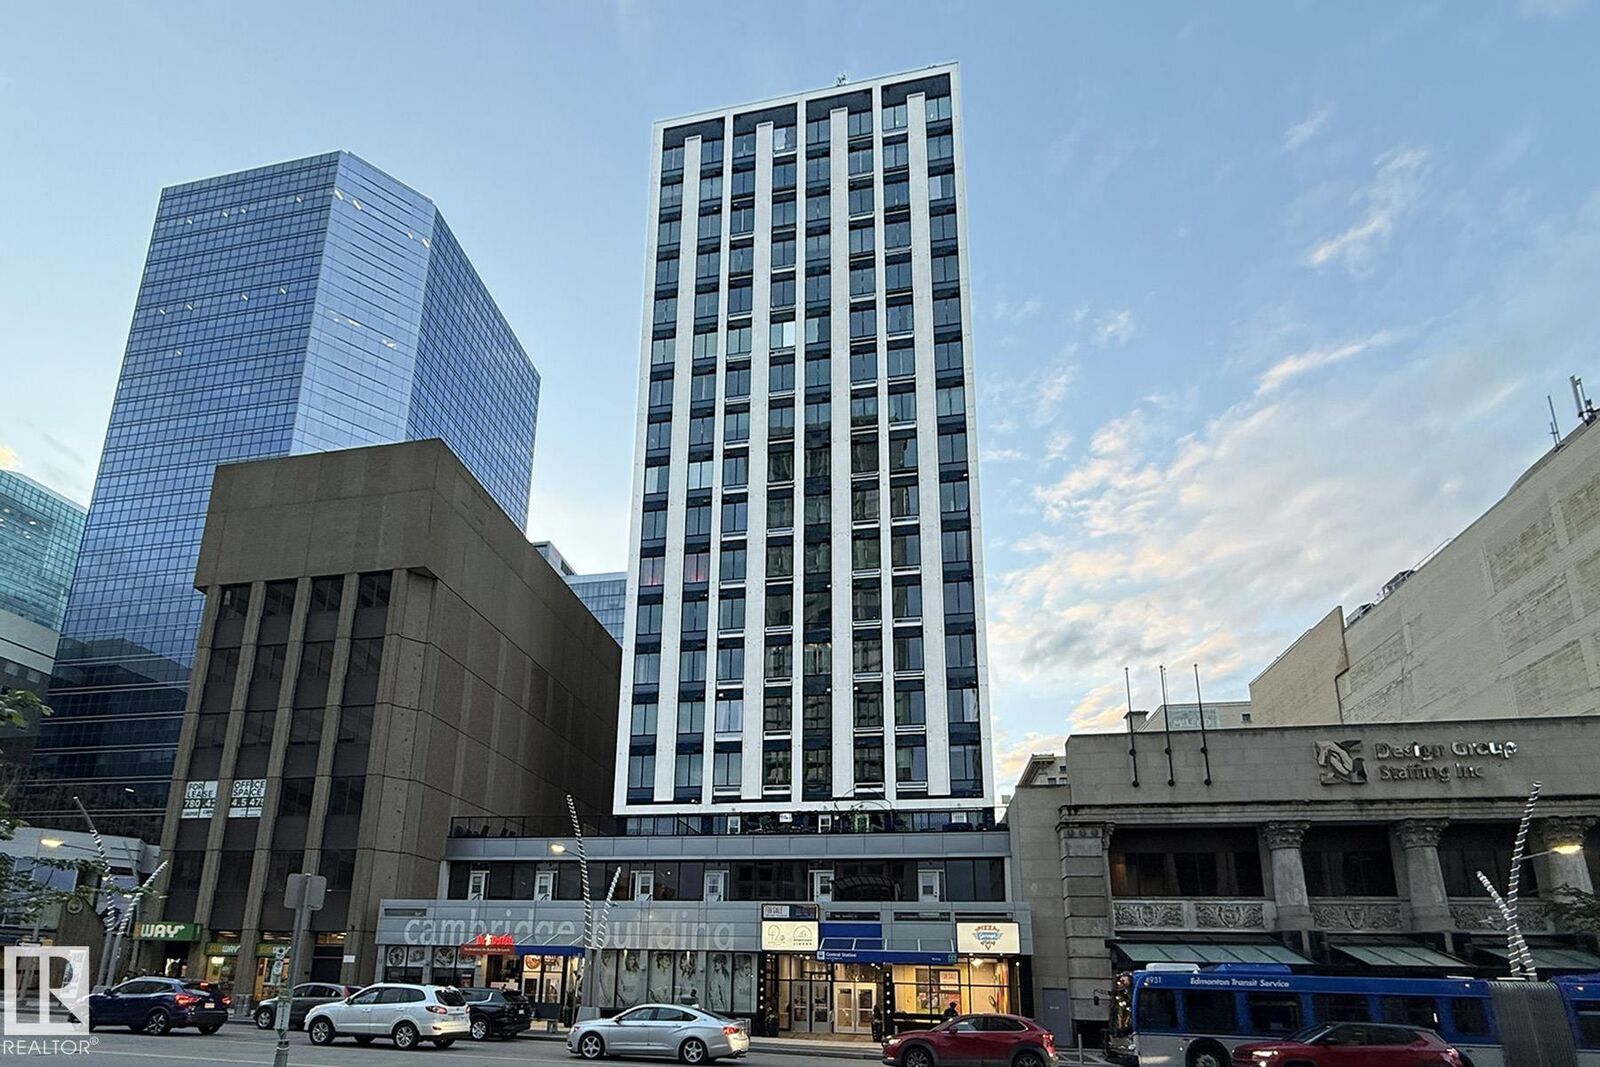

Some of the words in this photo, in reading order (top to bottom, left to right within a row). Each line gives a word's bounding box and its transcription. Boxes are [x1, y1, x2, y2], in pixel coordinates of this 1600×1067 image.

[1375, 742, 1444, 761] Design
[1451, 739, 1517, 759] Group
[1381, 764, 1450, 782] Staffing
[1190, 977, 1230, 986] Edmonton
[1232, 978, 1257, 987] Transit
[1259, 978, 1290, 987] Service
